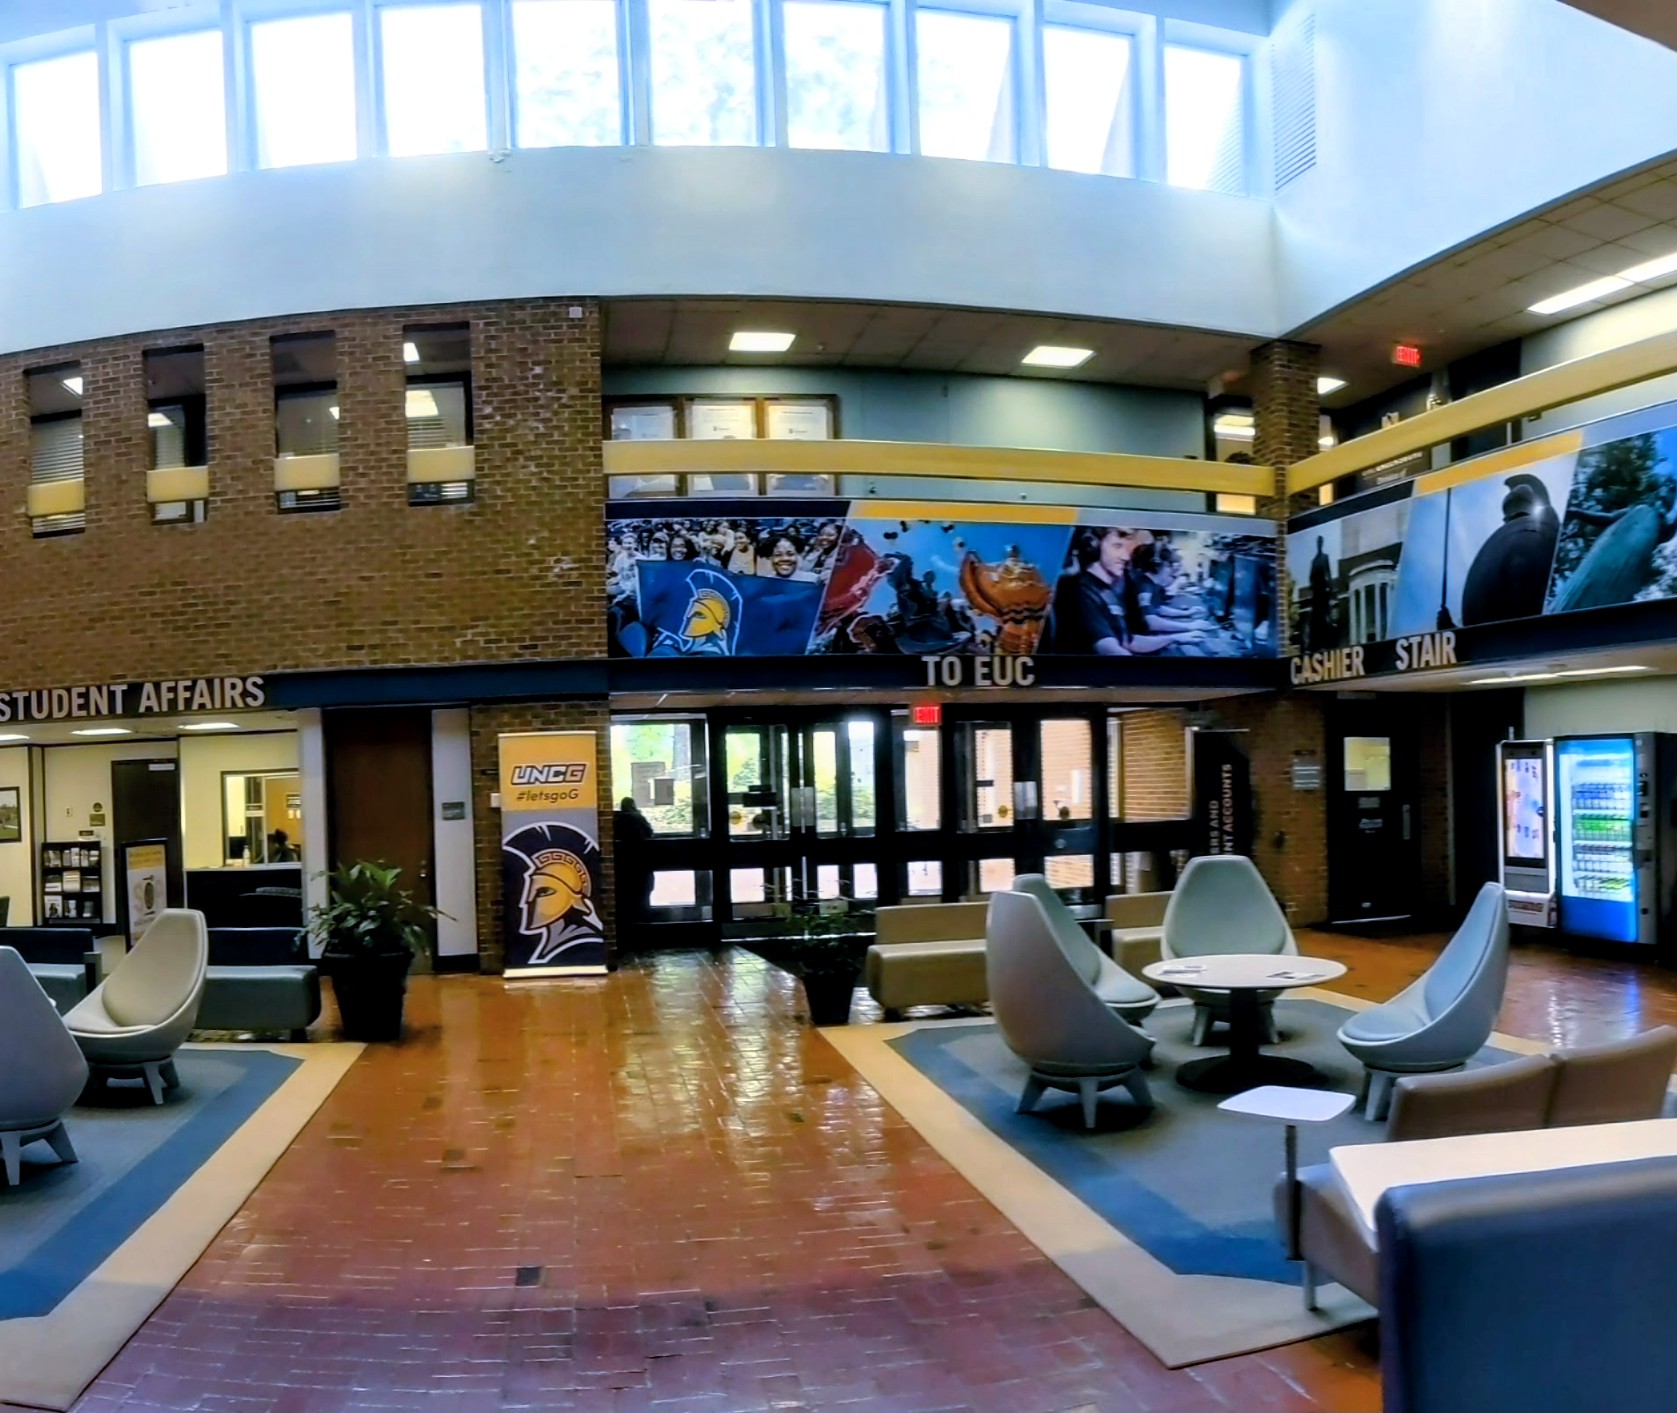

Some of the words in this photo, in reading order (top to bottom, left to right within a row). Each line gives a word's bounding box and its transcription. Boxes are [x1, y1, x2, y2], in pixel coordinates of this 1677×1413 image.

[921, 655, 962, 686] TO
[974, 655, 1035, 686] EUC
[1290, 645, 1365, 685] CASHIER
[1395, 631, 1457, 671] STAIR
[0, 684, 128, 722] STUDENT
[138, 676, 266, 713] AFFAIRS
[510, 762, 588, 787] UNCG
[516, 788, 579, 804] #letsgoG
[1222, 764, 1234, 832] ACCOUNTS
